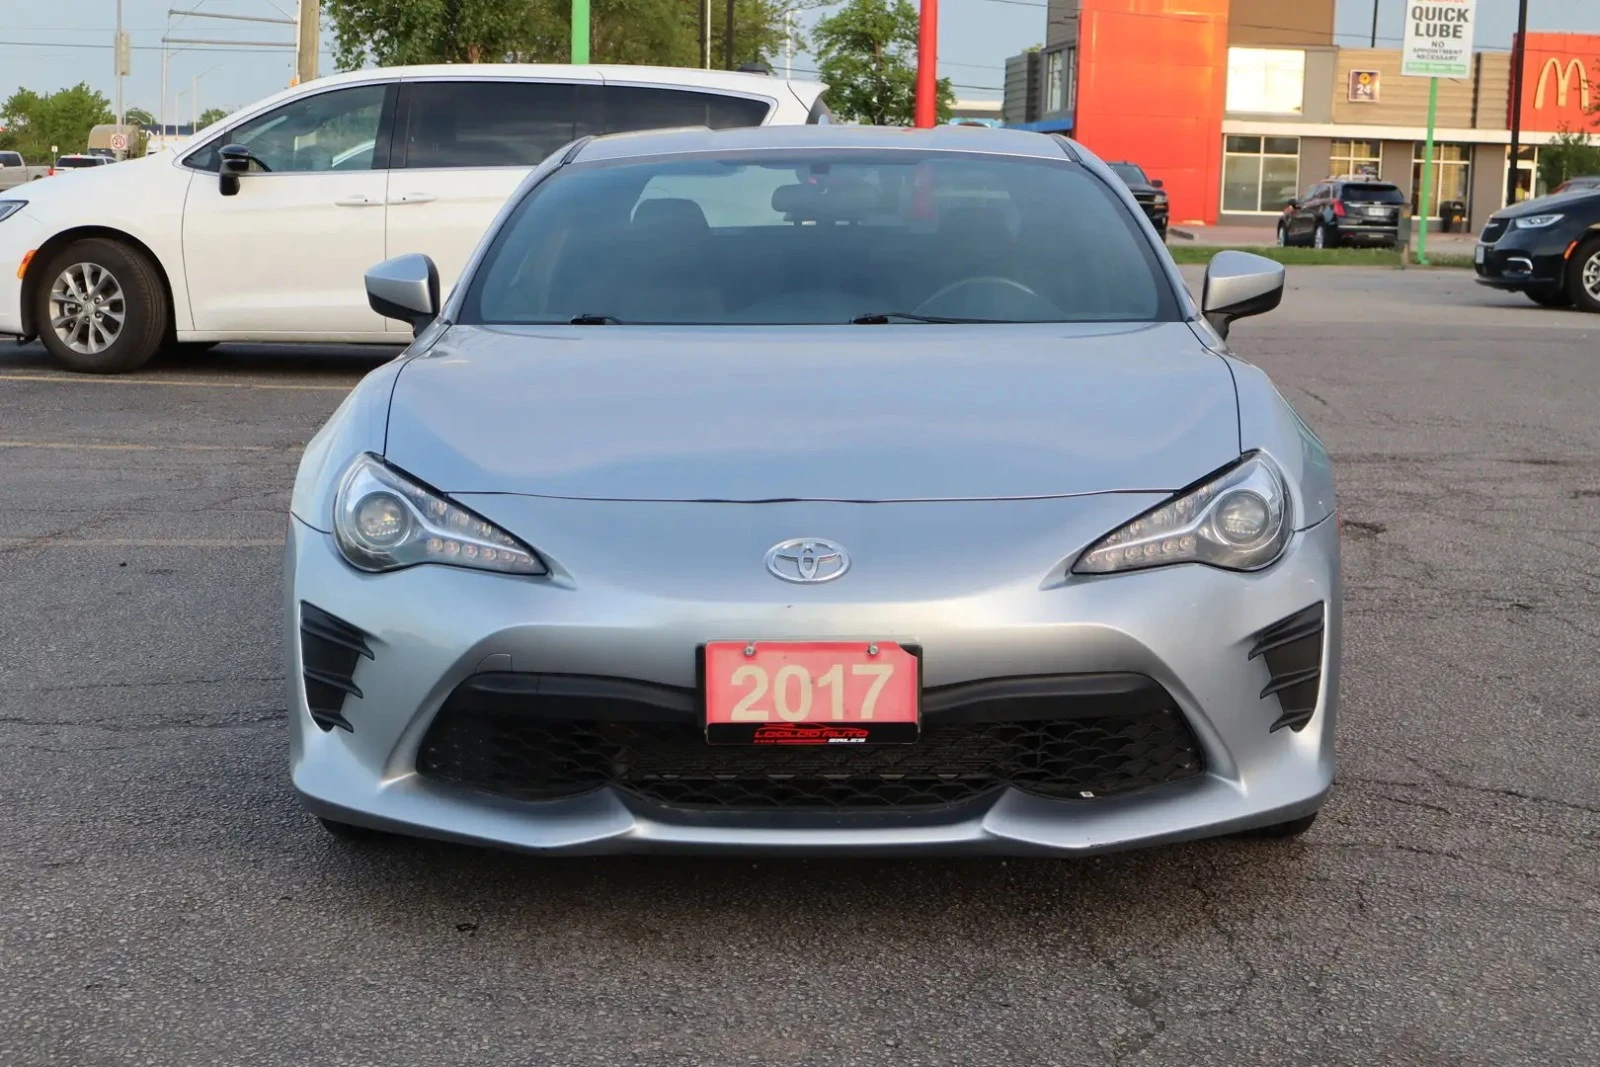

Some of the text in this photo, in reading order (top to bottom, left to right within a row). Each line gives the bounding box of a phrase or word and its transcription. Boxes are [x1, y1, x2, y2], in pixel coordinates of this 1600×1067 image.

[1411, 5, 1470, 23] QUICK
[1414, 22, 1464, 39] LUBE
[1413, 47, 1463, 55] APPOINTMENT
[730, 664, 895, 723] 2017
[820, 730, 869, 738] AUTO
